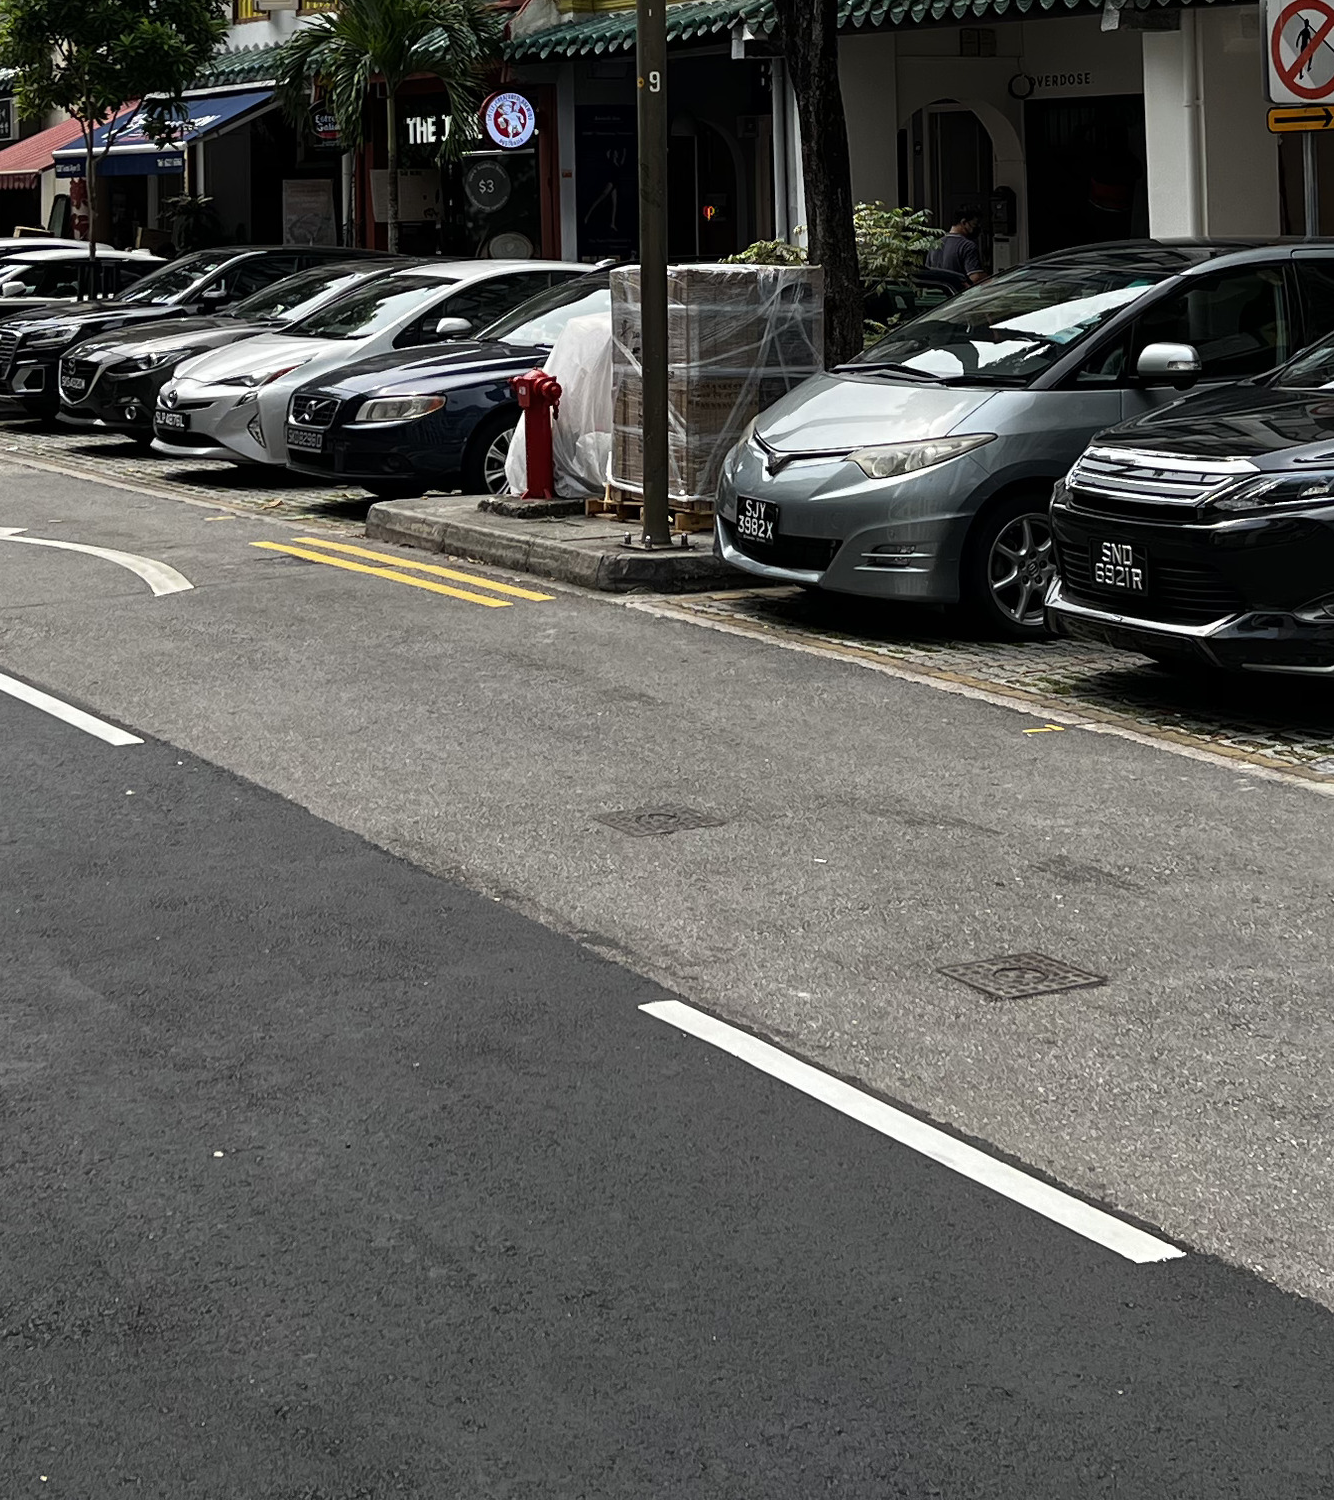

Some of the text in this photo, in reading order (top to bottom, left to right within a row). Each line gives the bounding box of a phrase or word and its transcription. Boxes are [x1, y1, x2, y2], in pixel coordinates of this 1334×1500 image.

[649, 71, 661, 93] 9
[406, 115, 437, 145] THE
[478, 178, 495, 195] $3
[745, 499, 767, 519] SJY
[737, 514, 774, 540] 3982X
[1101, 541, 1133, 567] SND
[1094, 562, 1144, 591] 6921R
